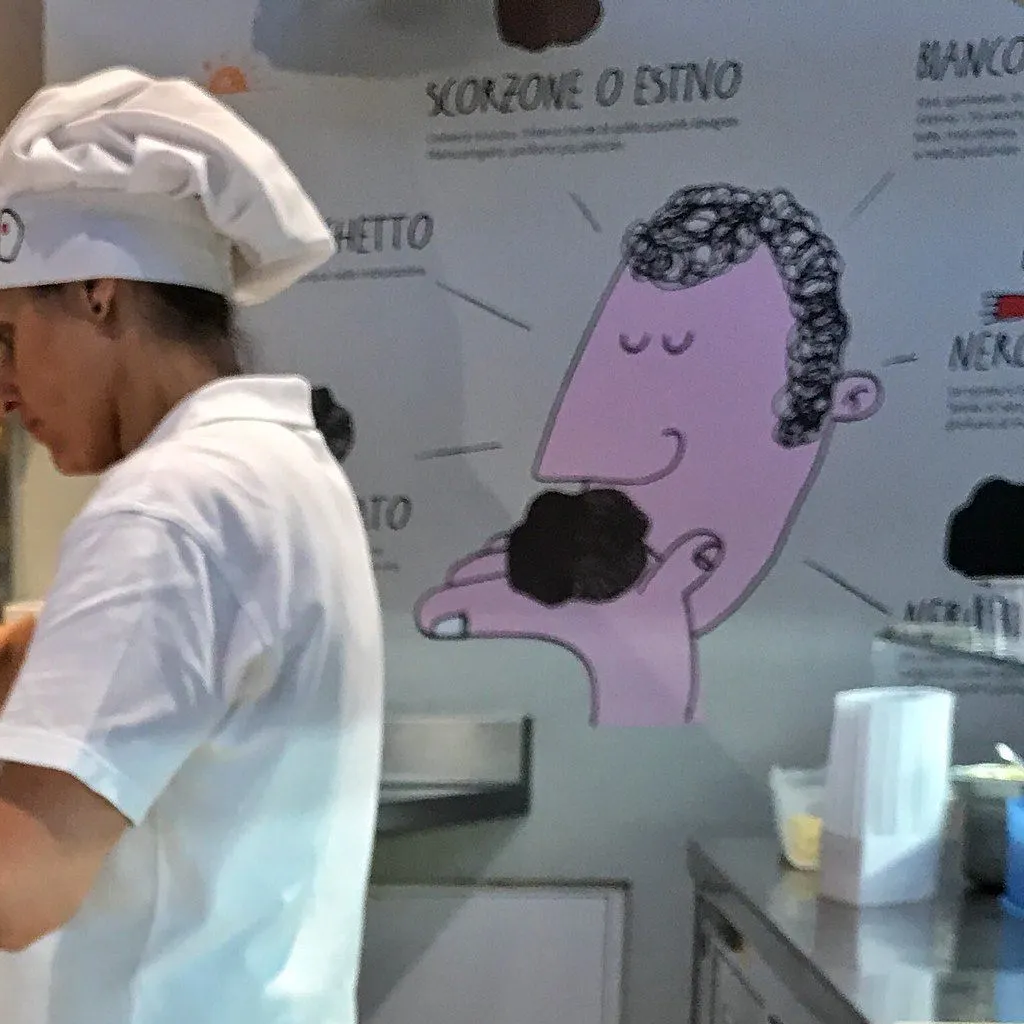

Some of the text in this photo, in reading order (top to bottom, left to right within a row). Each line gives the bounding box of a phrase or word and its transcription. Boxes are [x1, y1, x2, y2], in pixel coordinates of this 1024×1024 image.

[594, 66, 625, 107] O
[325, 212, 435, 254] HETTO
[359, 495, 413, 531] TO
